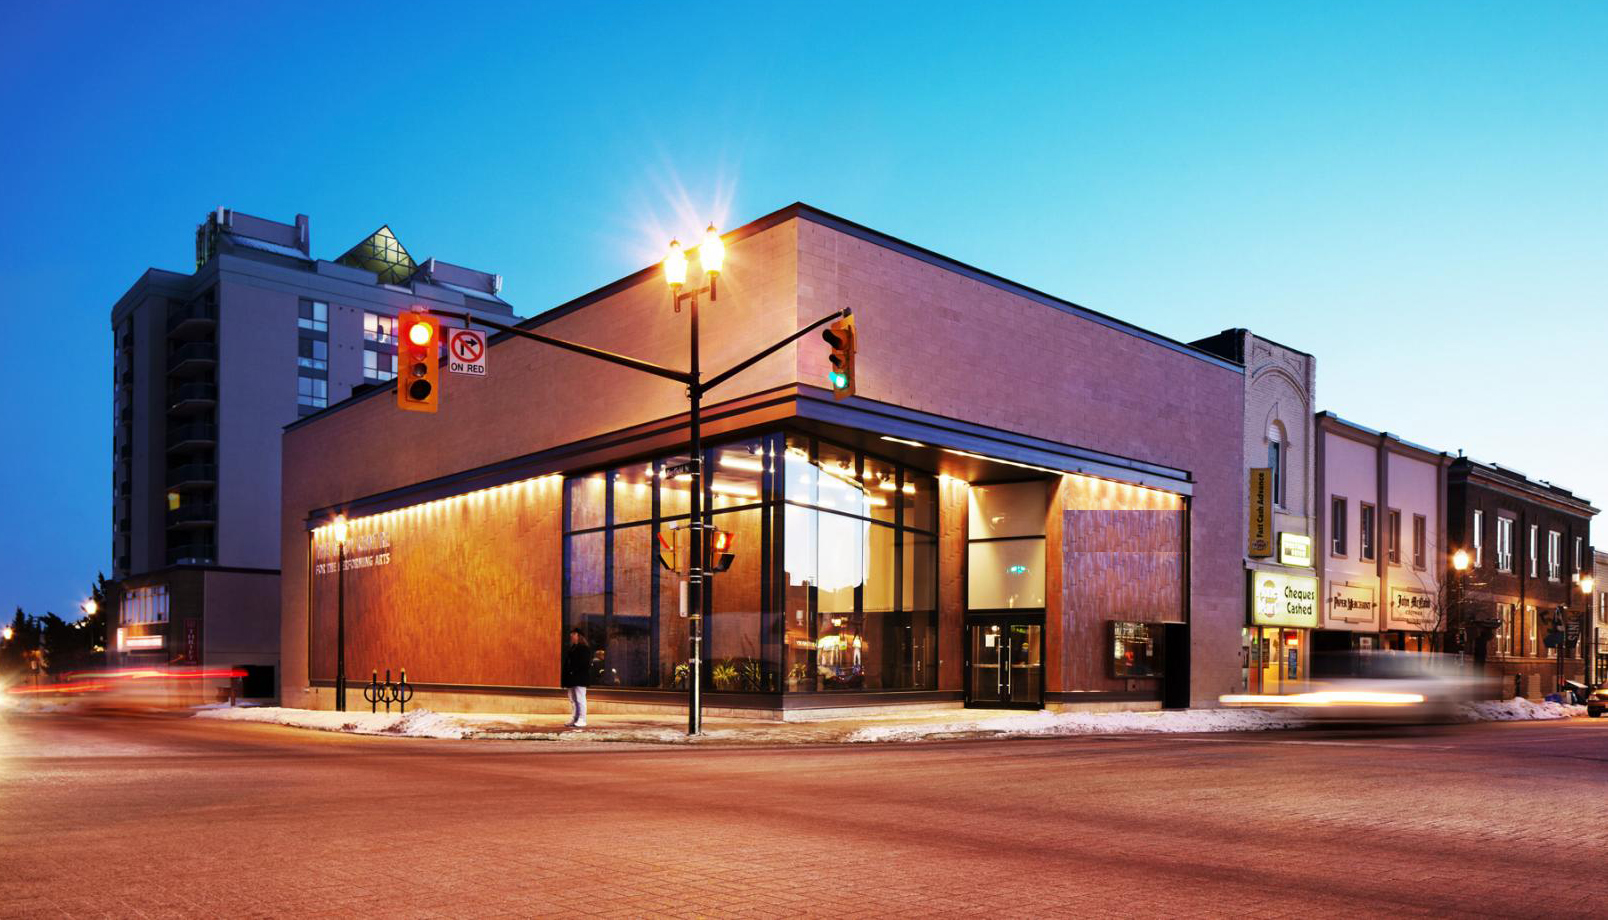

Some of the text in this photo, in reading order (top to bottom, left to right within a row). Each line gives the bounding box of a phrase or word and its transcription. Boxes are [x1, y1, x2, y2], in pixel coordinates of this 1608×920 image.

[451, 362, 485, 374] ON RED
[1256, 472, 1265, 505] Advance
[1256, 505, 1264, 522] Cash
[1256, 523, 1264, 538] Fast
[338, 556, 373, 571] ERFORMING
[375, 553, 390, 566] ARTS
[1284, 585, 1315, 602] Cheques
[1286, 601, 1313, 615] Cashed
[1347, 598, 1371, 610] MERCHANT
